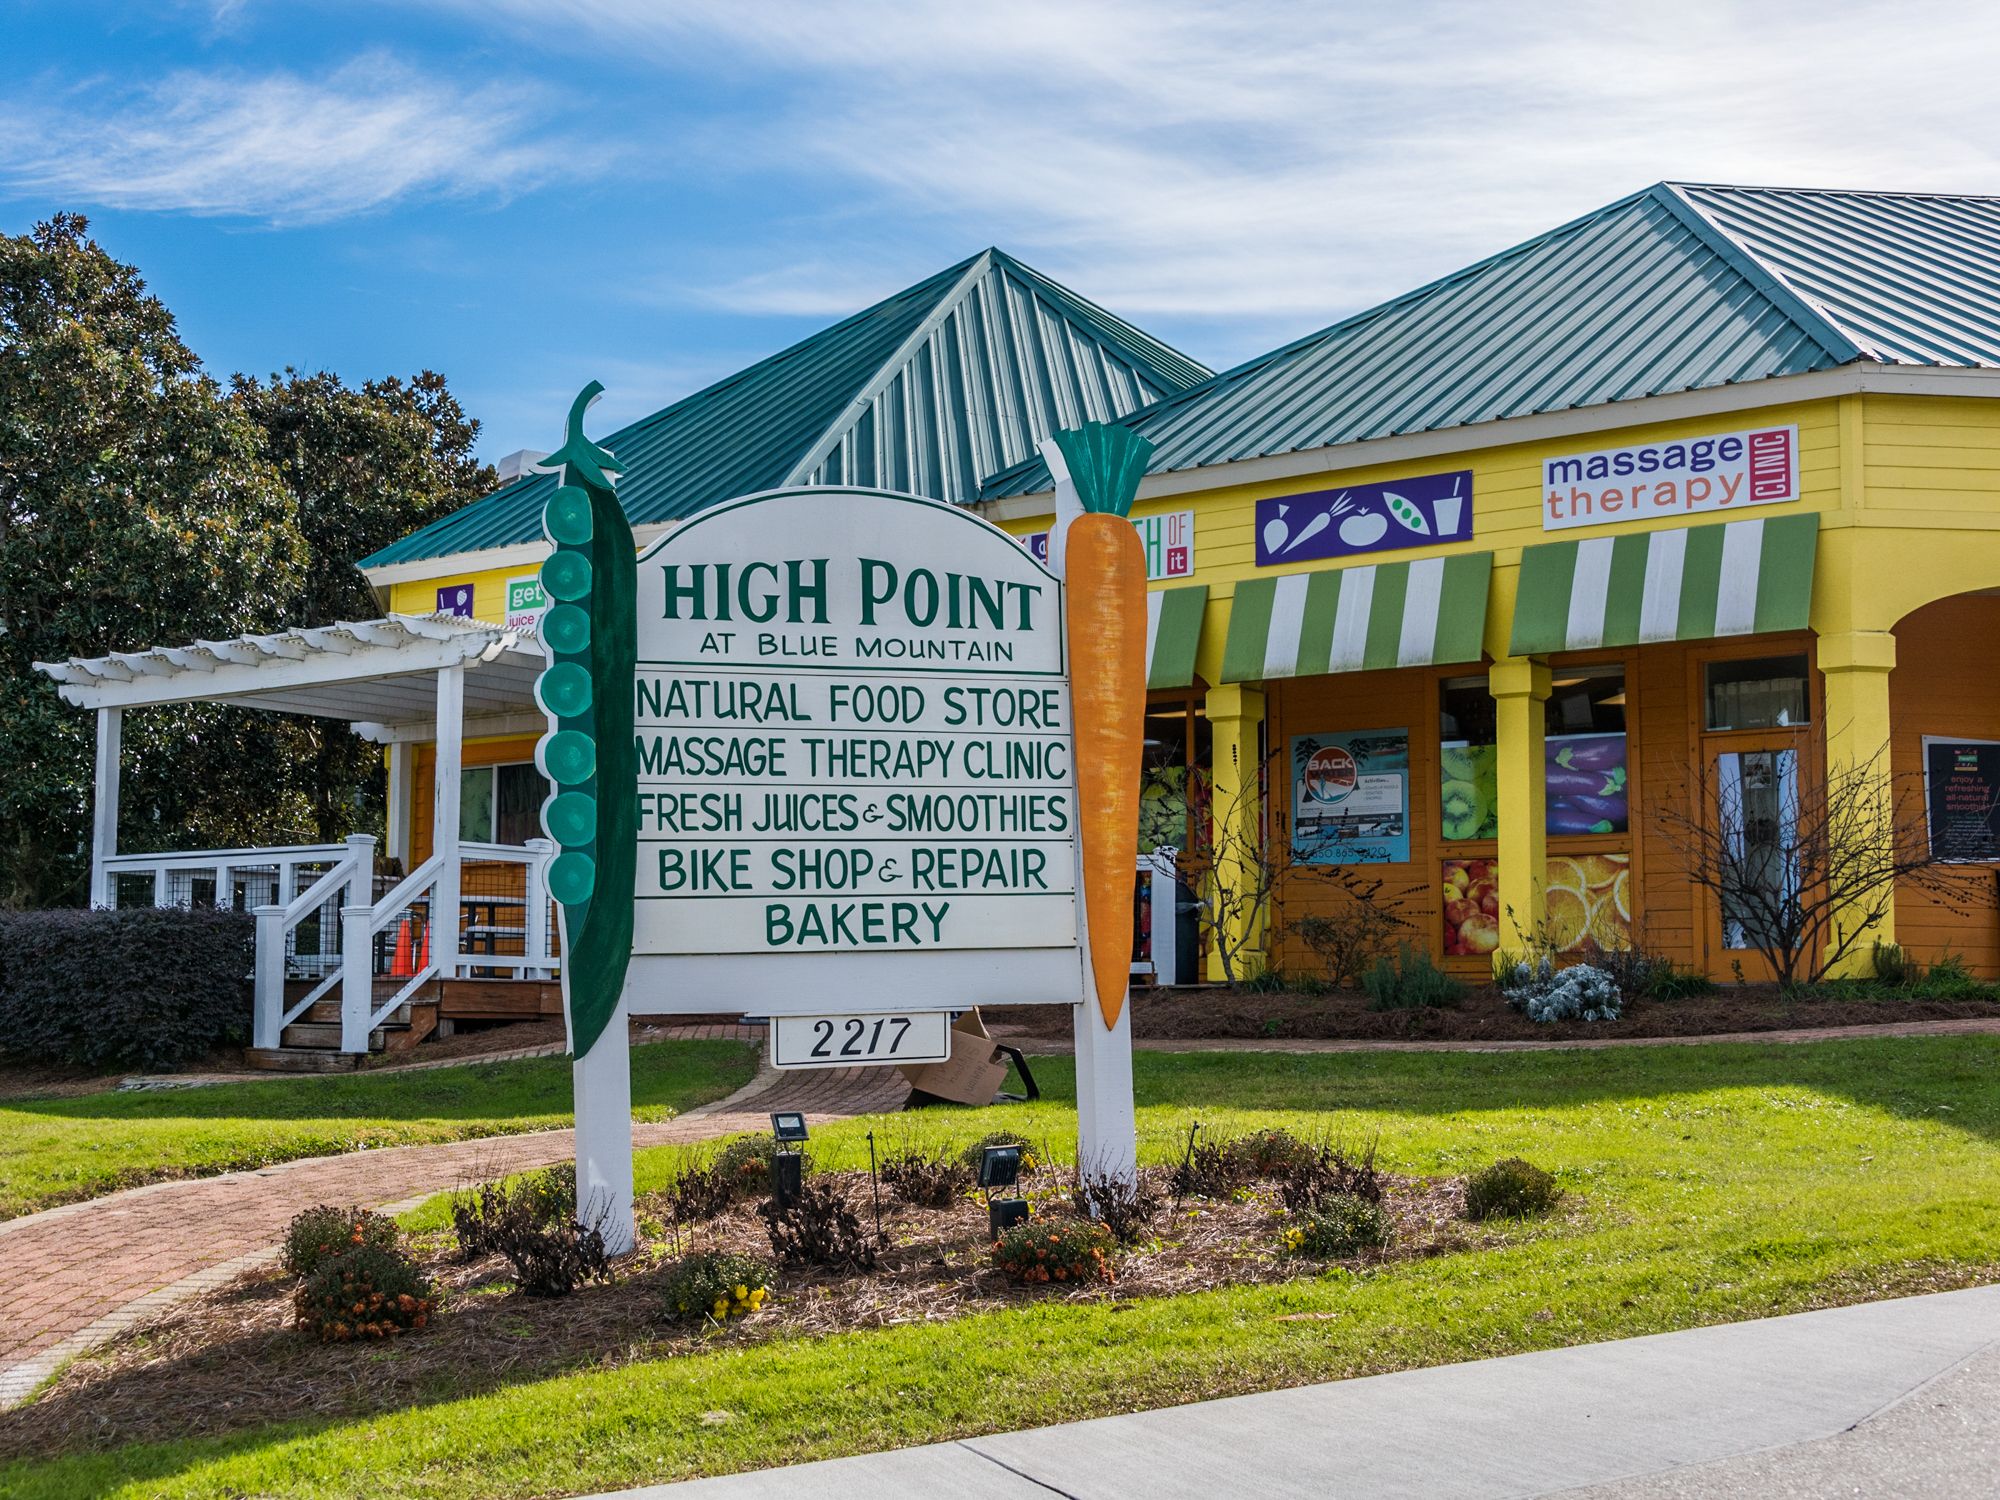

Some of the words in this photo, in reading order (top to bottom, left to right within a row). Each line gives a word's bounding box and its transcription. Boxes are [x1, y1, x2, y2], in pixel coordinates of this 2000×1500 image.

[1548, 436, 1743, 485] massage
[1754, 434, 1786, 497] CLINIC
[1547, 471, 1744, 519] therapy
[1168, 513, 1187, 546] OF
[1170, 552, 1185, 571] it
[512, 582, 542, 607] get
[661, 559, 831, 624] HIGH
[858, 557, 1042, 631] POINT
[700, 633, 736, 653] AT
[759, 633, 837, 656] BLUE
[856, 638, 1012, 661] MOUNTAIN
[637, 679, 812, 723] NATURAL
[830, 685, 924, 723] FOOD
[944, 687, 1060, 729] STORE
[636, 735, 787, 778] MASSAGE
[801, 739, 954, 779] THERAPY
[964, 741, 1066, 779] CLINIC
[1308, 758, 1354, 770] BACK
[638, 794, 742, 833] FRESH
[752, 794, 858, 831] JUICES
[863, 804, 884, 823] &
[887, 794, 1067, 832] SMOOTHIES
[659, 849, 752, 892] BIKE
[771, 849, 873, 890] SHOP
[879, 858, 902, 882] &
[912, 849, 1048, 891] REPAIR
[766, 902, 949, 946] BAKERY
[810, 1017, 912, 1057] 2217
